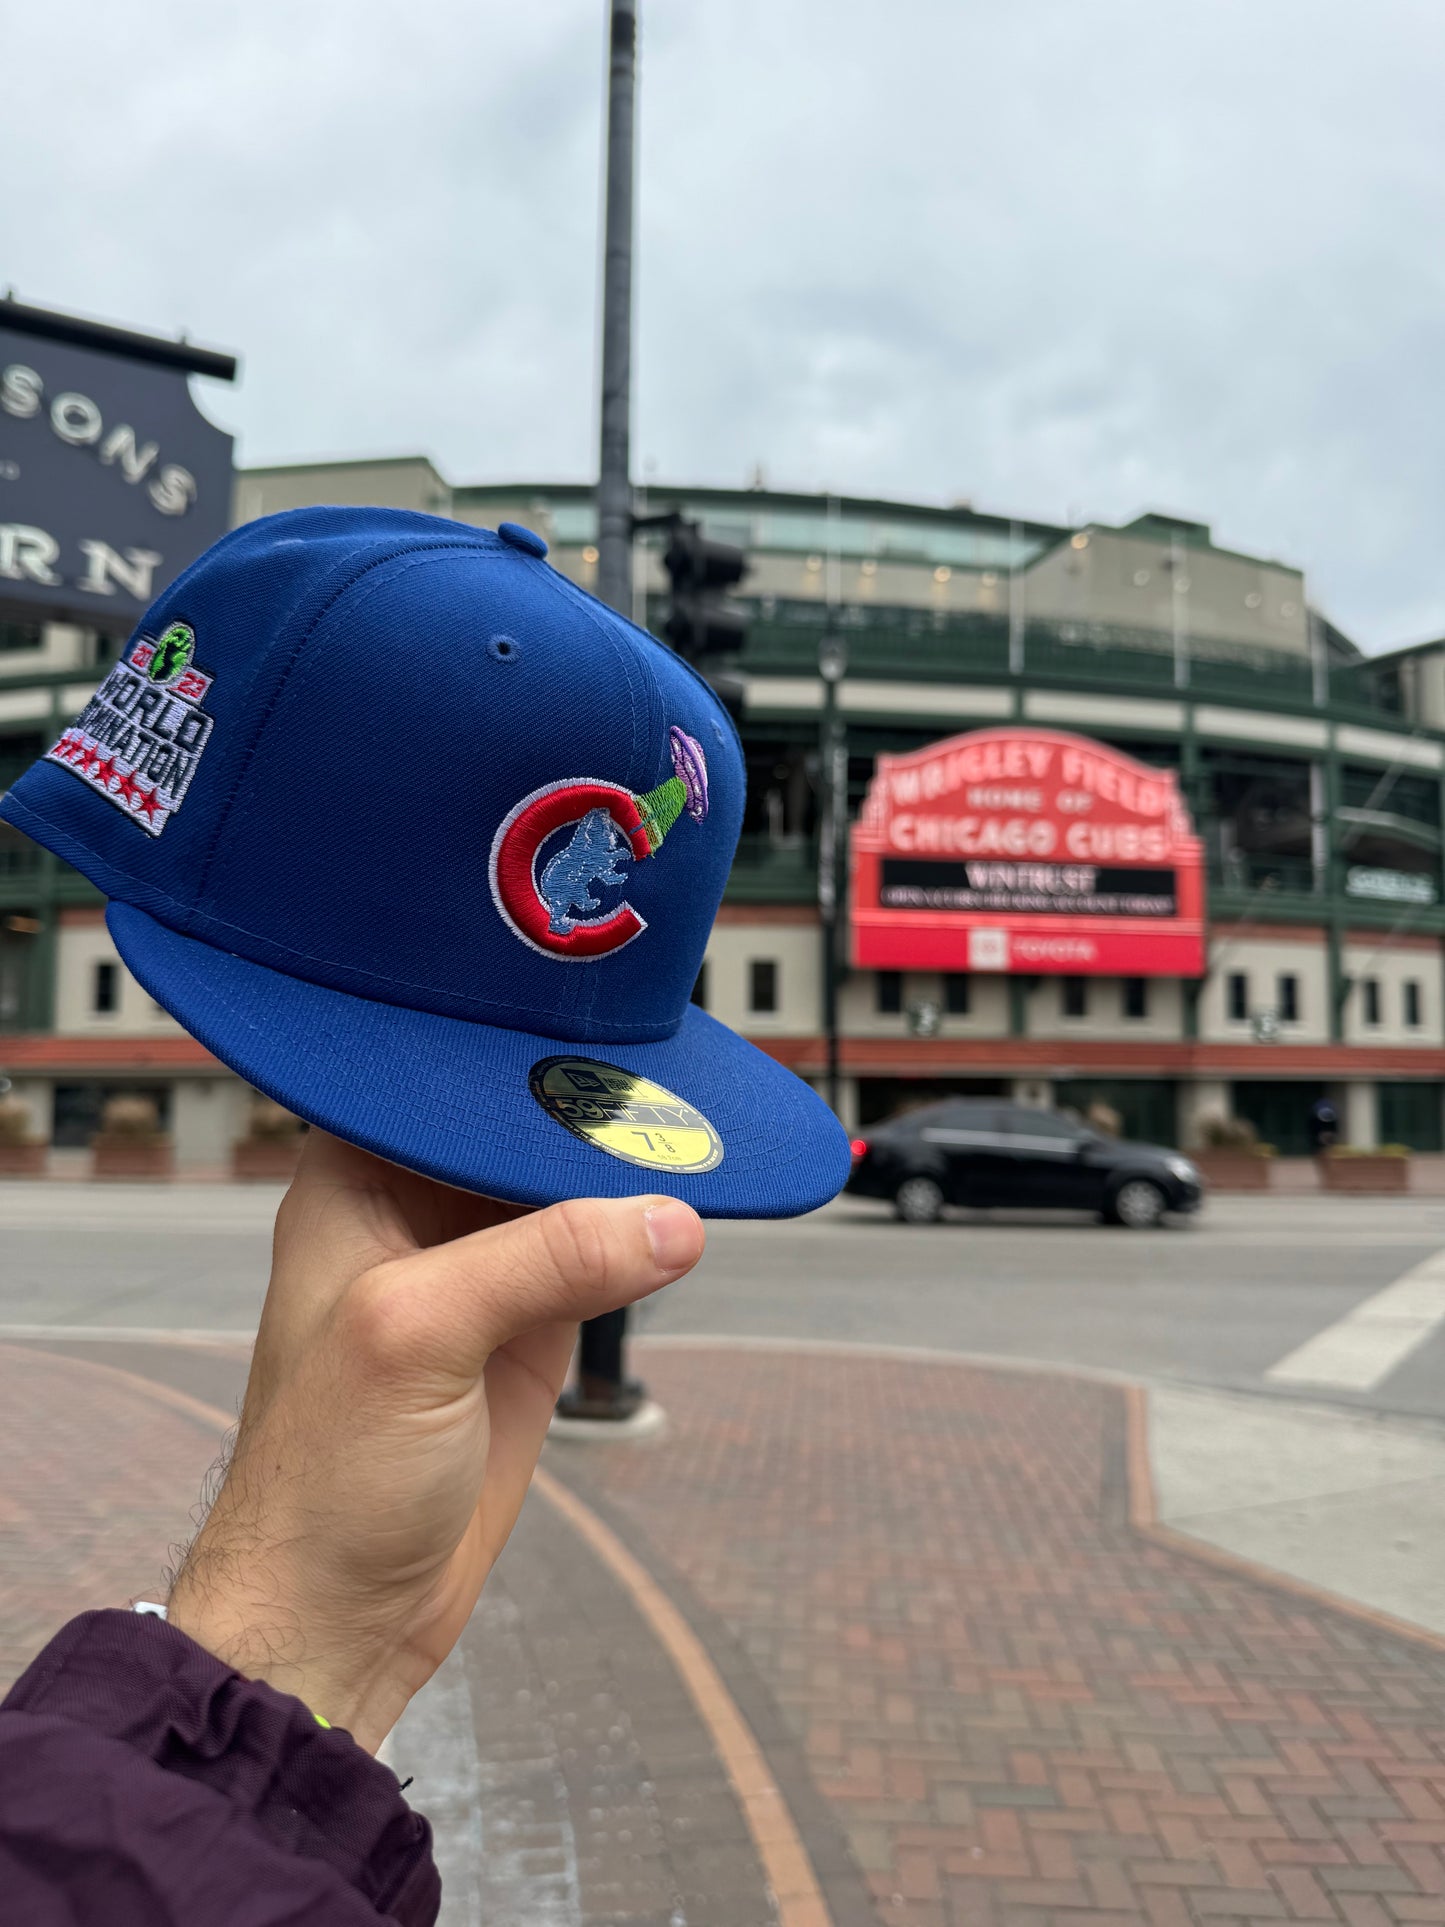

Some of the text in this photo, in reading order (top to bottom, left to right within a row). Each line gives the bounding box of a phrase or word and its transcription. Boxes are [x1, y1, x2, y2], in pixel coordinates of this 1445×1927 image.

[177, 671, 206, 698] 23
[99, 668, 214, 751] WORLD
[889, 741, 1167, 817] WRIGLEY FIELD
[966, 787, 1094, 814] HOME OF
[890, 813, 1168, 862] CHICAGO CUBS
[554, 1098, 689, 1126] 59FIFTY
[631, 1131, 655, 1151] 7
